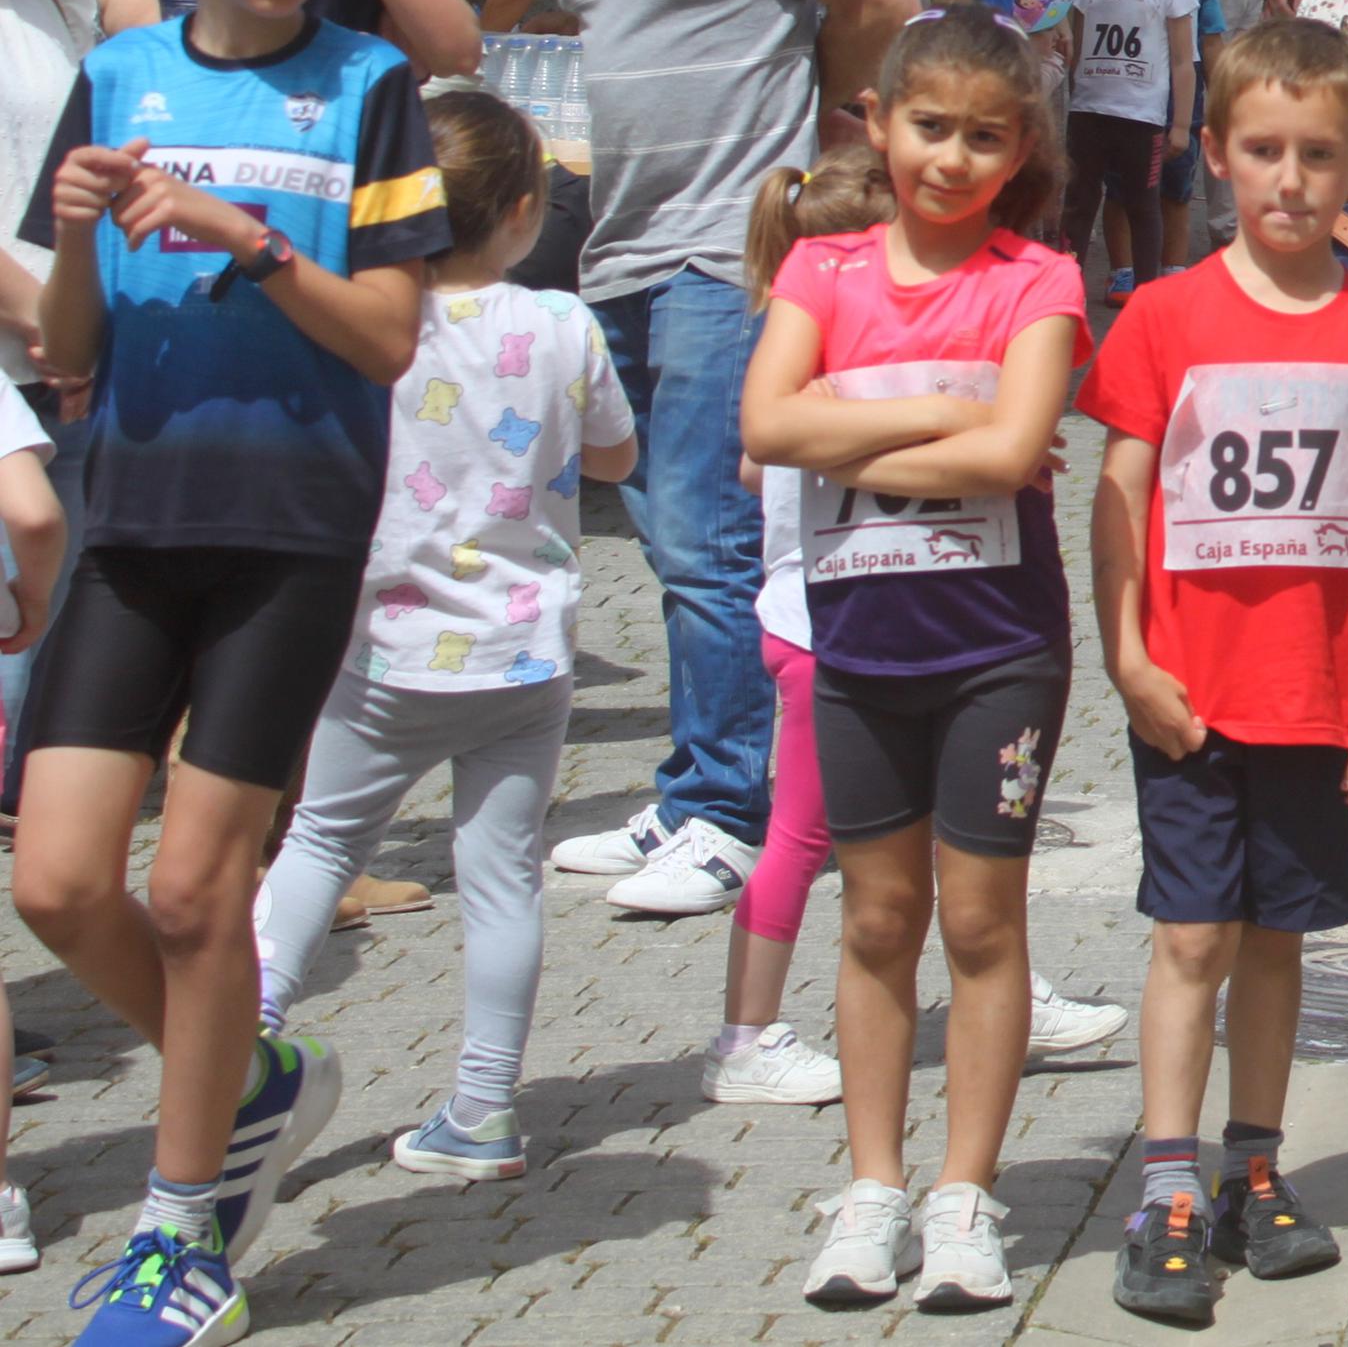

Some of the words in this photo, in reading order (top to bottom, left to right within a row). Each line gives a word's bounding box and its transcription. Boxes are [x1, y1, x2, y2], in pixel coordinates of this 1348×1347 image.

[1092, 24, 1142, 58] 706
[233, 162, 346, 199] DUERO
[1209, 428, 1341, 512] 857
[814, 554, 847, 578] Caja
[850, 549, 917, 569] España
[1195, 541, 1233, 563] Caja
[1239, 539, 1308, 560] España
